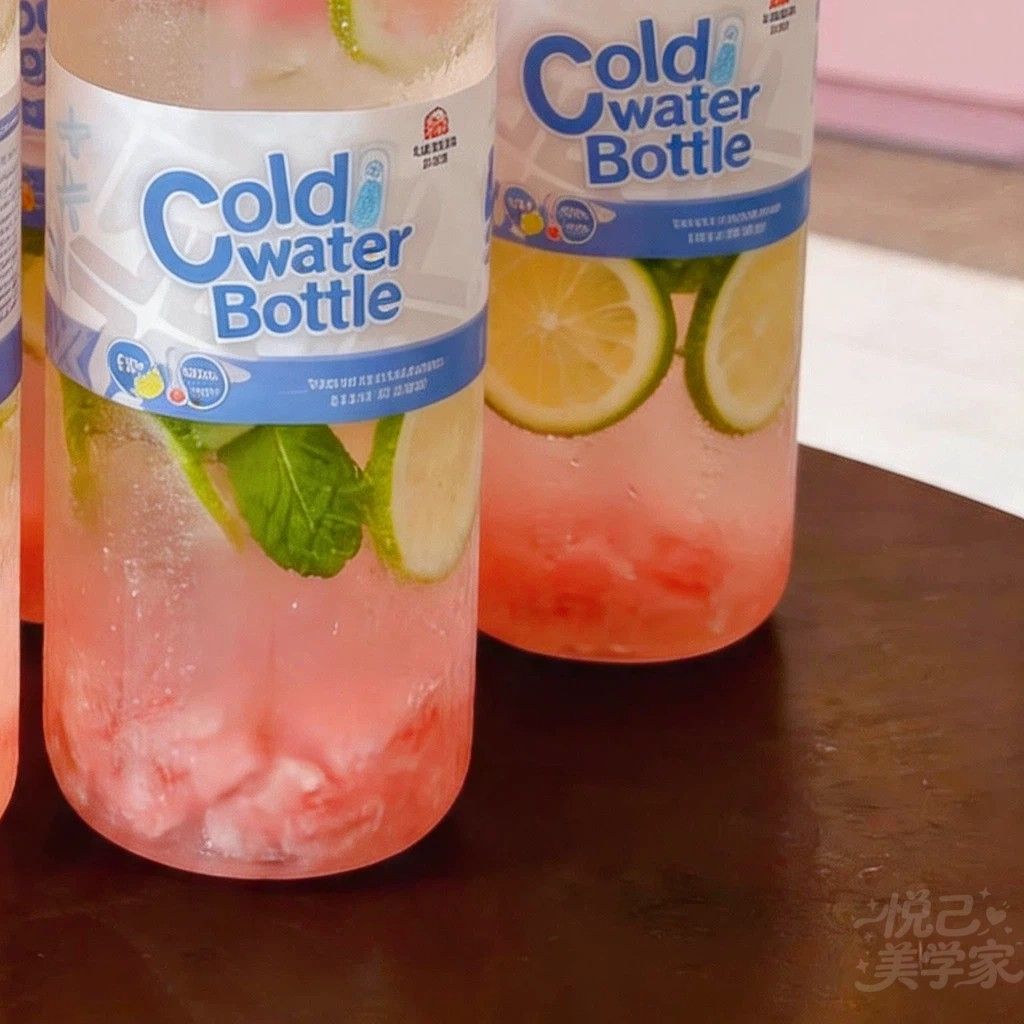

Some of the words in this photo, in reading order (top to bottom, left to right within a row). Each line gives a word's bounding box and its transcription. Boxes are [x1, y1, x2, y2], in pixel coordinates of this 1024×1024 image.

[523, 18, 711, 135] Cold
[608, 84, 761, 132] water
[585, 126, 752, 185] Bottle
[142, 152, 350, 284] Cold
[238, 225, 413, 282] water
[212, 276, 402, 339] Bottle
